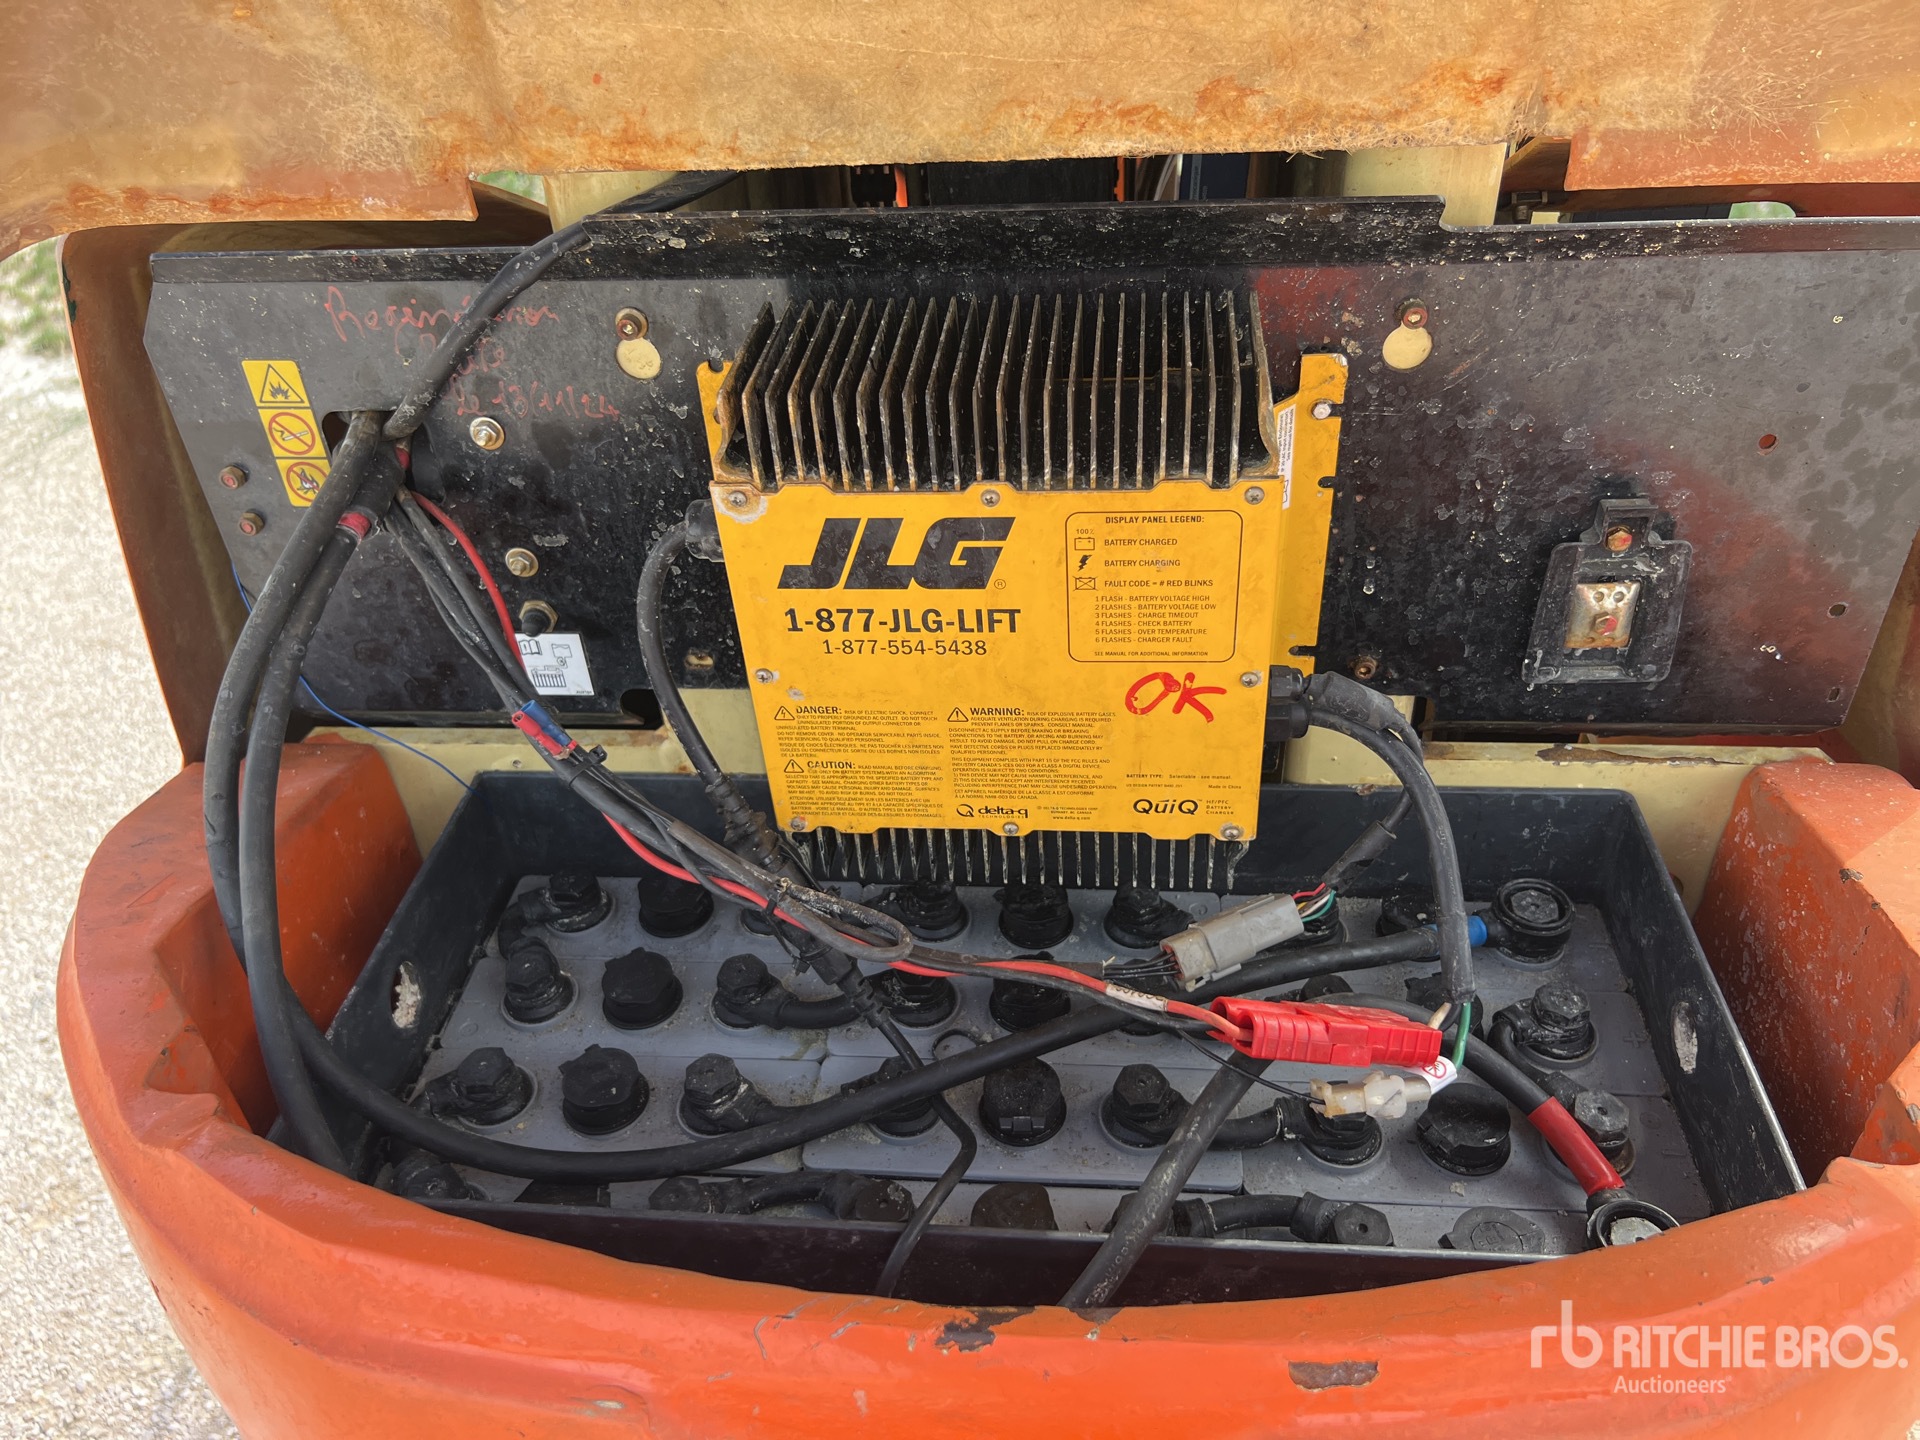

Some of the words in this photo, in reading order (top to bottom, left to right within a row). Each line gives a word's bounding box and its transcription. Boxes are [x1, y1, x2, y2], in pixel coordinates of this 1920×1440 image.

[1105, 516, 1139, 524] DISPLAY
[1142, 516, 1167, 524] PANEL
[777, 517, 1016, 590] JLG
[784, 608, 1021, 633] 1-877-JLG-LIFT
[822, 639, 987, 656] 1-877-554-5438
[1125, 672, 1227, 723] OK
[796, 706, 842, 714] DANGER:
[970, 708, 1025, 716] WARNING:
[807, 761, 855, 769] CAUTION:
[978, 806, 1028, 818] delta-q
[1133, 799, 1199, 815] QuiQ
